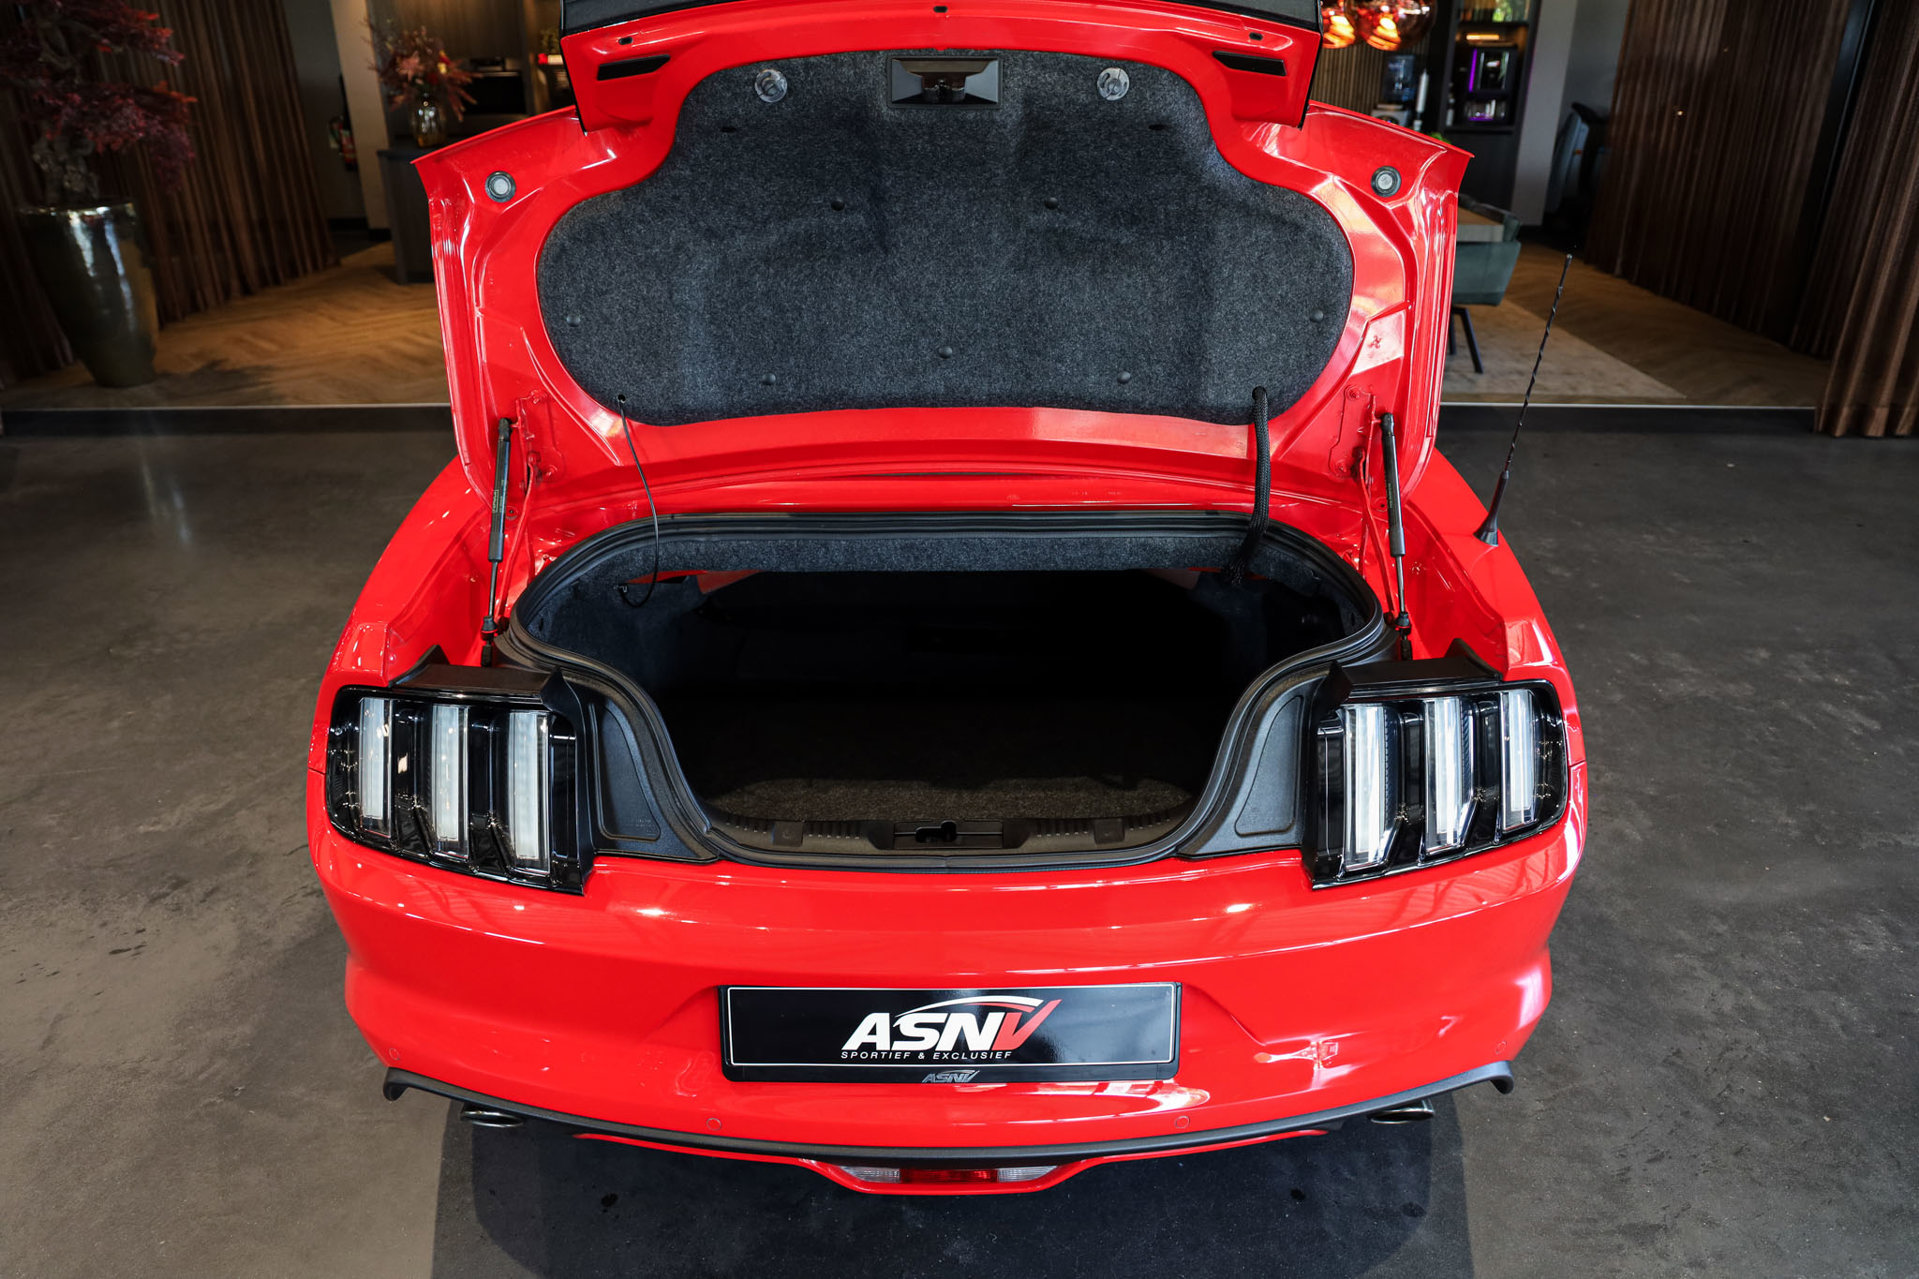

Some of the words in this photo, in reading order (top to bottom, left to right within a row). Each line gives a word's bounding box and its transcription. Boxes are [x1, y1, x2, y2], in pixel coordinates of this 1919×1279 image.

[841, 998, 1063, 1051] ASNV
[840, 1051, 911, 1060] SPORTIEF
[917, 1051, 926, 1060] &
[932, 1051, 1013, 1060] EXCLUSIEF
